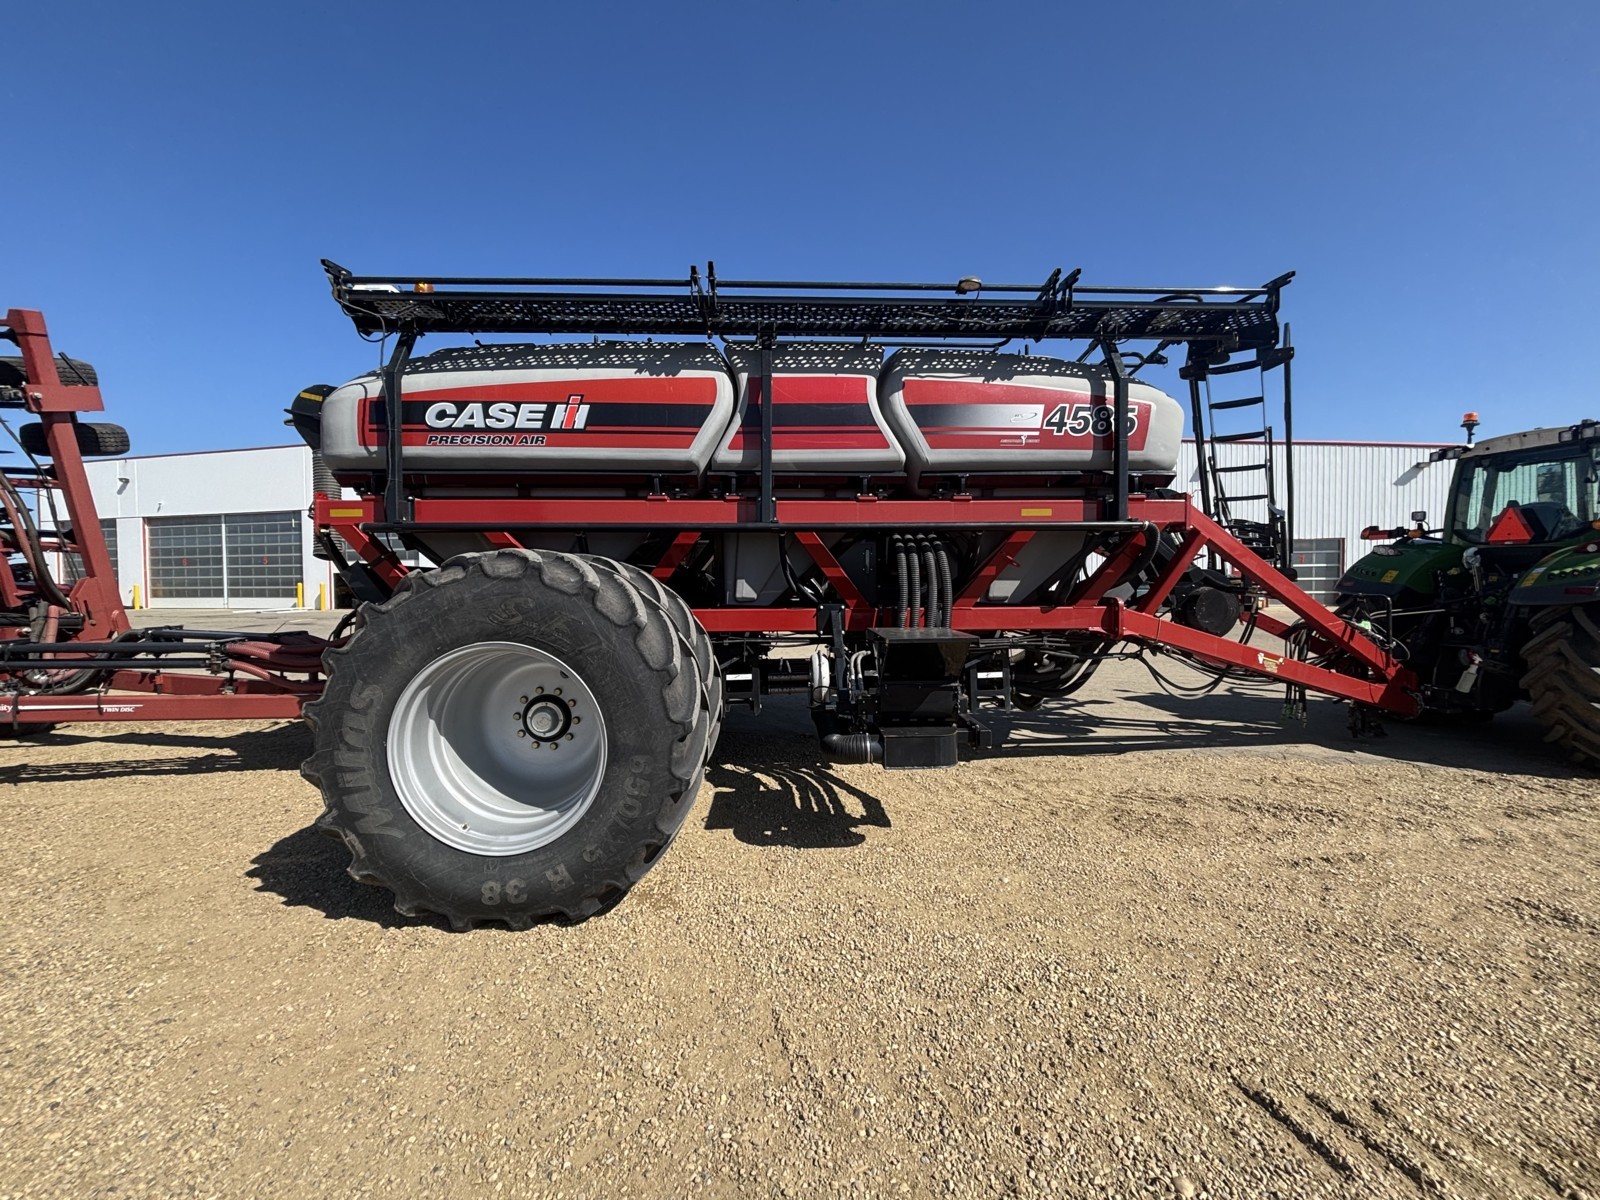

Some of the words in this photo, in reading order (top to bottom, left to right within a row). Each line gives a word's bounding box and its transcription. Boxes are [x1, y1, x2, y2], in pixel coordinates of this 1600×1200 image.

[425, 402, 547, 428] CASE
[427, 434, 514, 445] PRECISION
[516, 434, 546, 446] AIR
[0, 704, 13, 712] ity
[481, 877, 528, 905] 38
